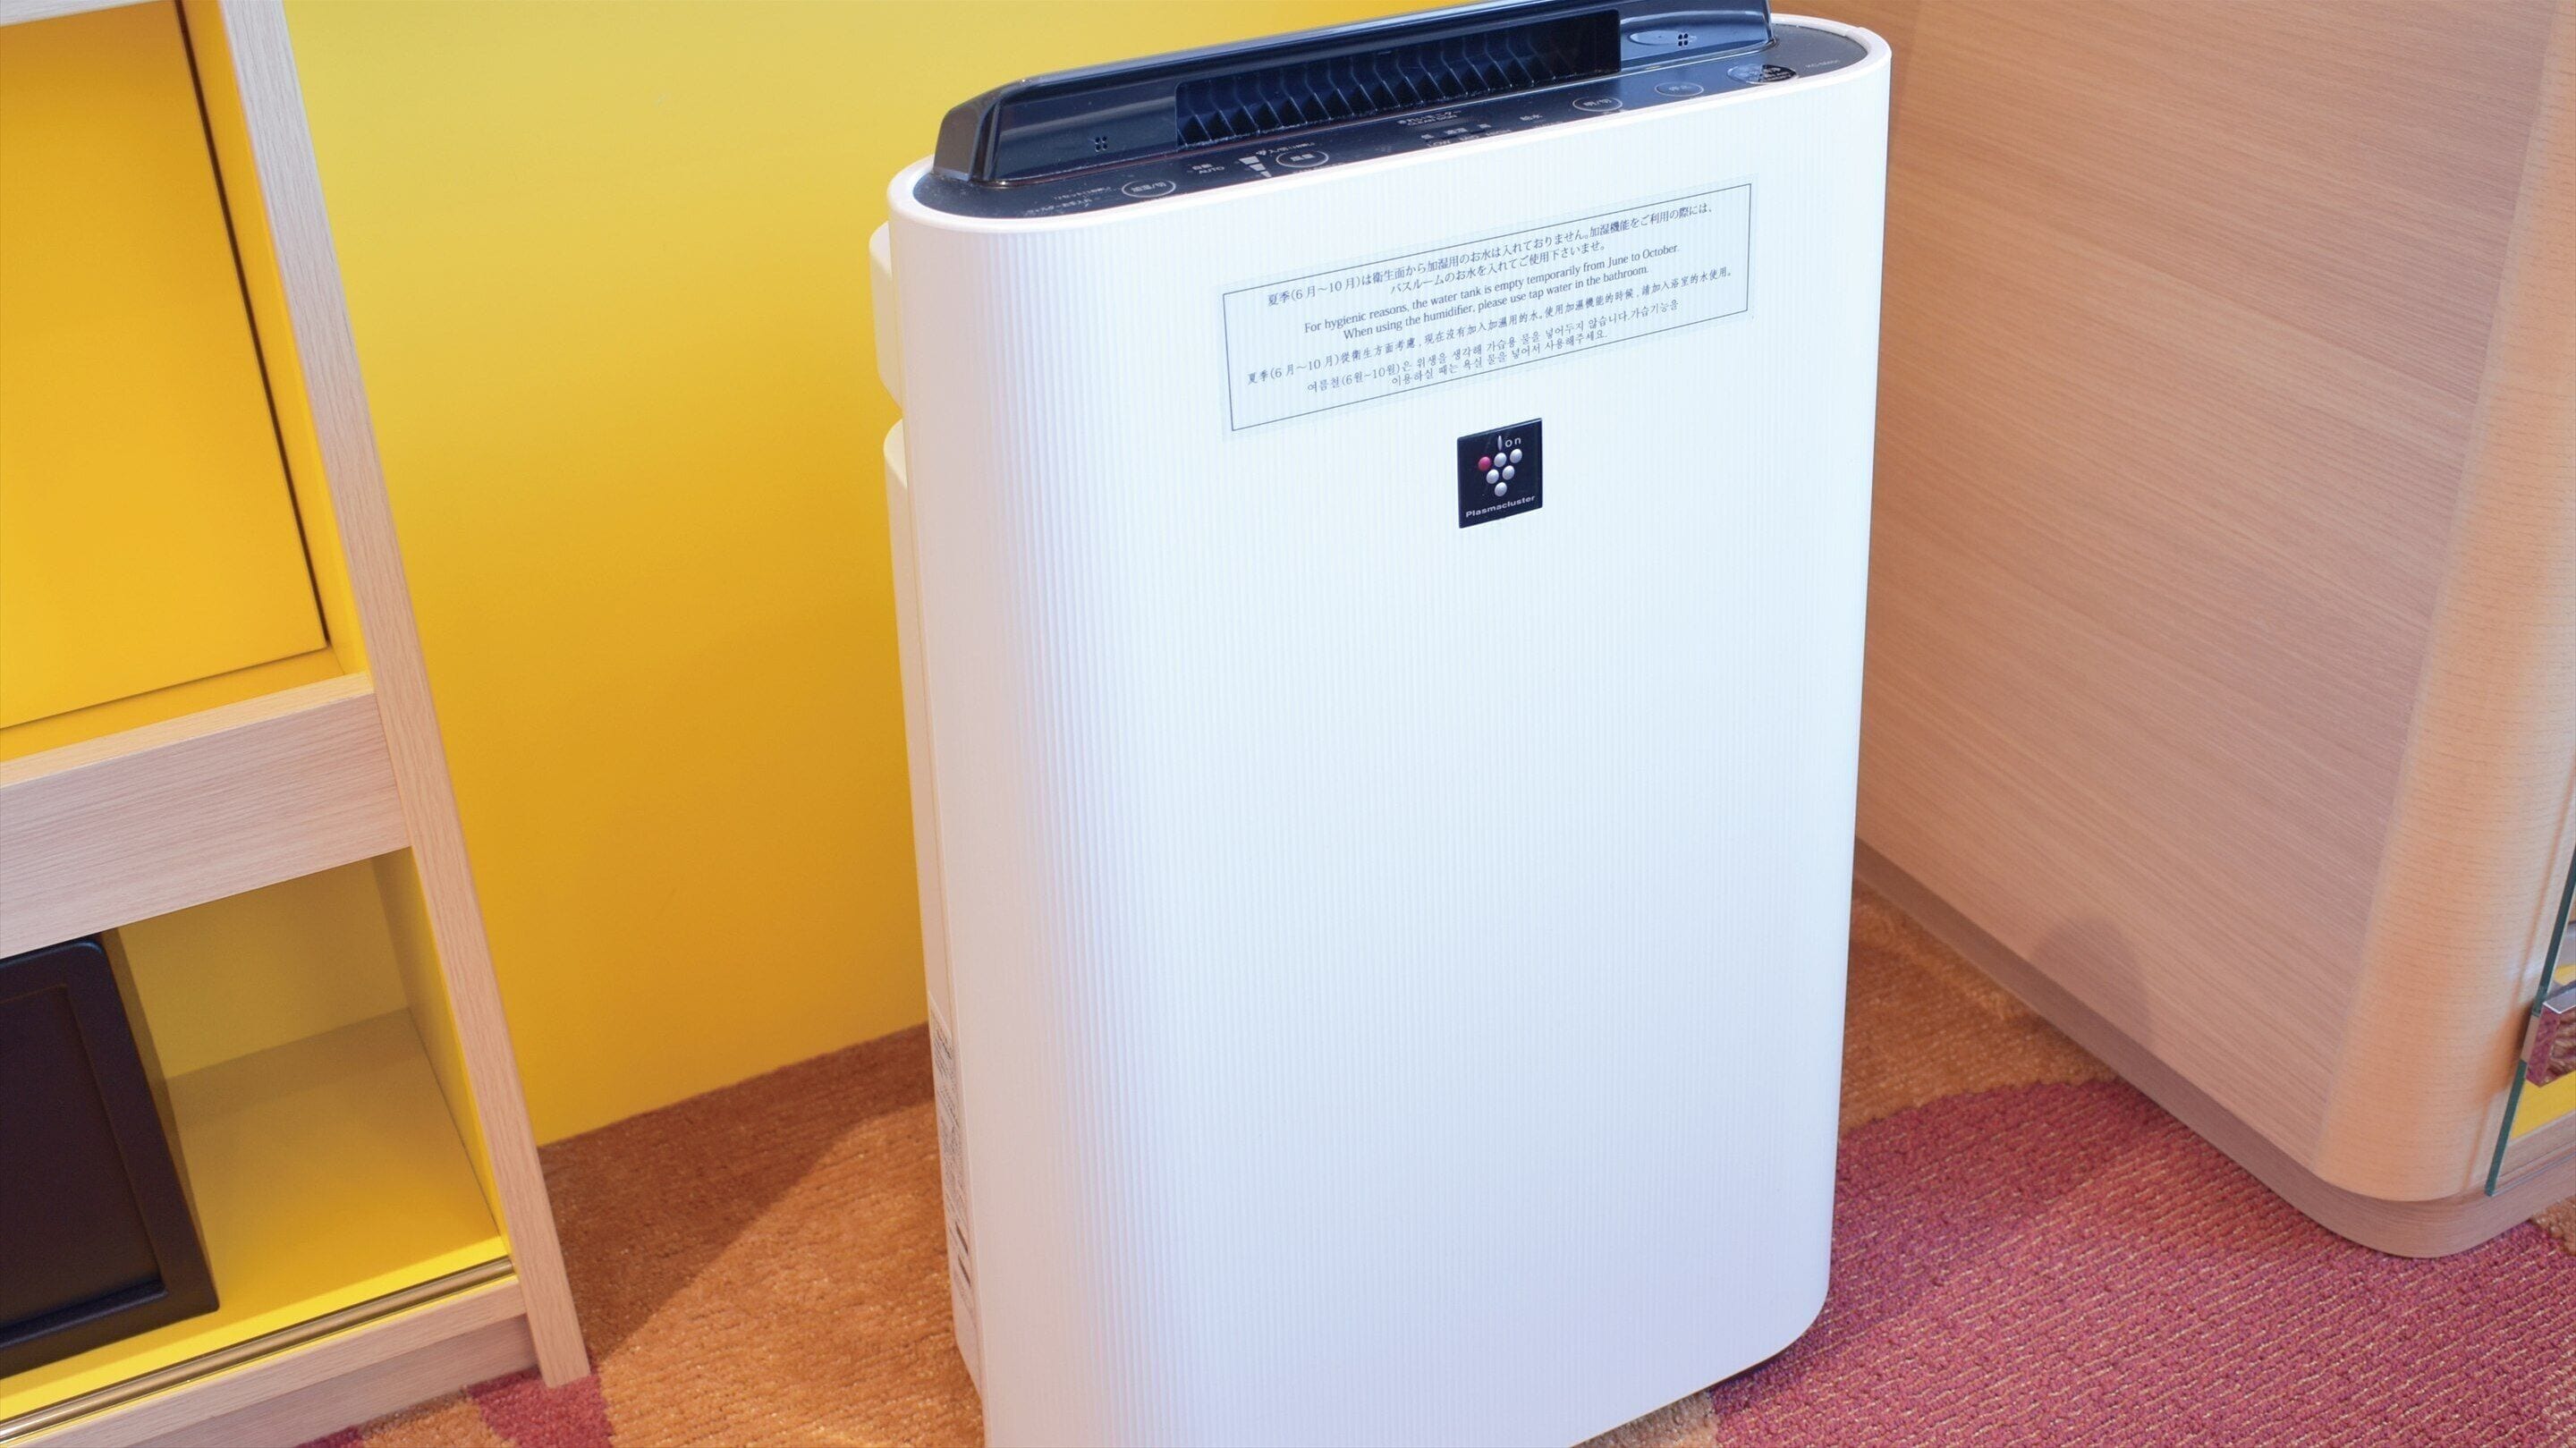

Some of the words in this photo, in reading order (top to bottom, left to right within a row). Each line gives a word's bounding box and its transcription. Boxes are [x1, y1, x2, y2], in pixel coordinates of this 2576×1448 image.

[1199, 165, 1225, 174] AUTO
[1304, 319, 1321, 333] For
[1325, 310, 1366, 331] hygienic
[1369, 304, 1409, 320] reasons,
[1412, 297, 1428, 309] the
[1430, 292, 1457, 305] water
[1460, 285, 1481, 299] tank
[1484, 284, 1491, 293] is
[1495, 277, 1523, 294] empty
[1527, 264, 1580, 287] temporarily
[1583, 258, 1604, 272] from
[1607, 253, 1628, 267] June
[1631, 252, 1640, 261] to
[1642, 241, 1679, 258] October.
[1343, 324, 1373, 340] When
[1376, 318, 1402, 335] using
[1405, 314, 1419, 326] the
[1423, 301, 1475, 323] humidifier,
[1478, 295, 1507, 312] please
[1510, 293, 1526, 303] use
[1529, 288, 1543, 301] tap
[1546, 282, 1572, 295] water
[1575, 278, 1583, 289] in
[1587, 275, 1600, 286] the
[1603, 264, 1648, 282] bathroom.
[1392, 367, 1434, 388] 이용하실
[1438, 361, 1458, 377] 때는
[1465, 495, 1536, 518] Plasmacluster
